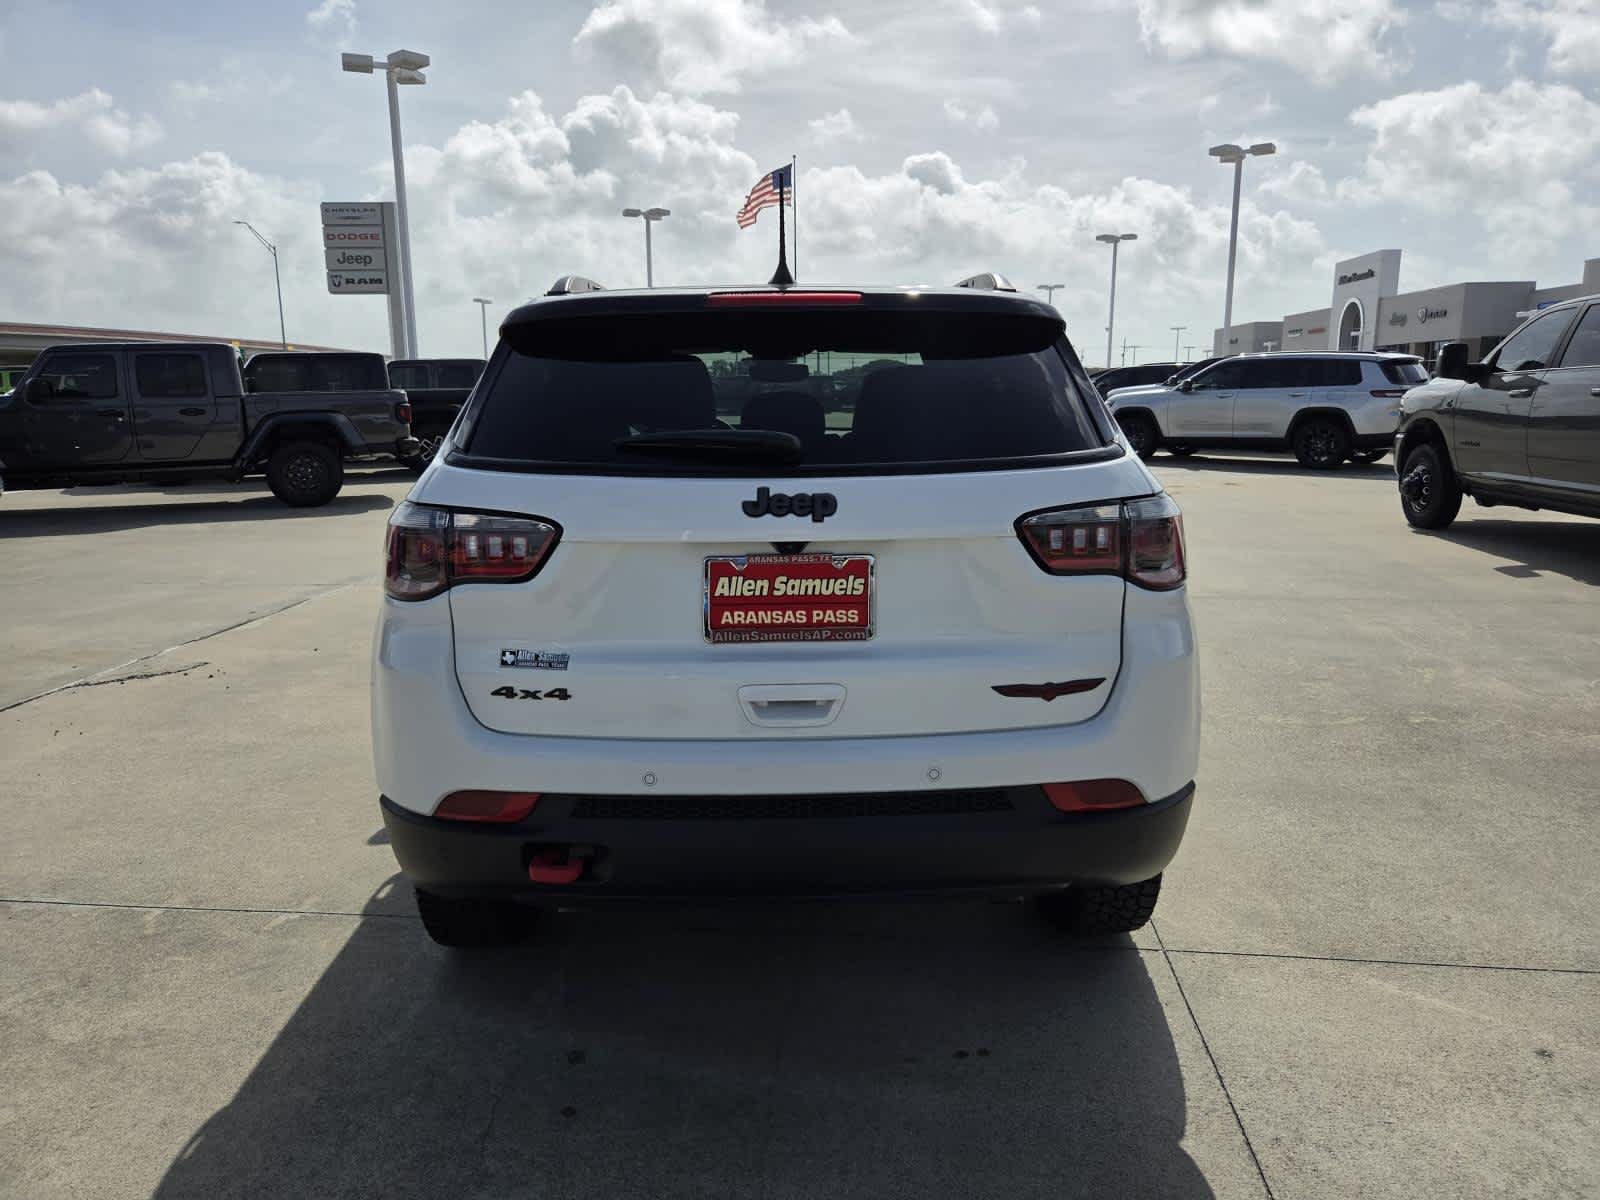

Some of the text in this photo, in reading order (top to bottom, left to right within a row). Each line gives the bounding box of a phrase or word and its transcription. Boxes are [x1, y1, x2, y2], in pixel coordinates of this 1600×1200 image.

[336, 252, 372, 266] Jeep
[742, 487, 837, 522] Jeep
[749, 555, 790, 564] ARANSAS
[714, 575, 865, 597] Allen Samuels
[721, 609, 859, 625] ARANSAS PASS
[714, 630, 866, 642] AllenSamuelsAP.com
[490, 686, 572, 700] 4x4
